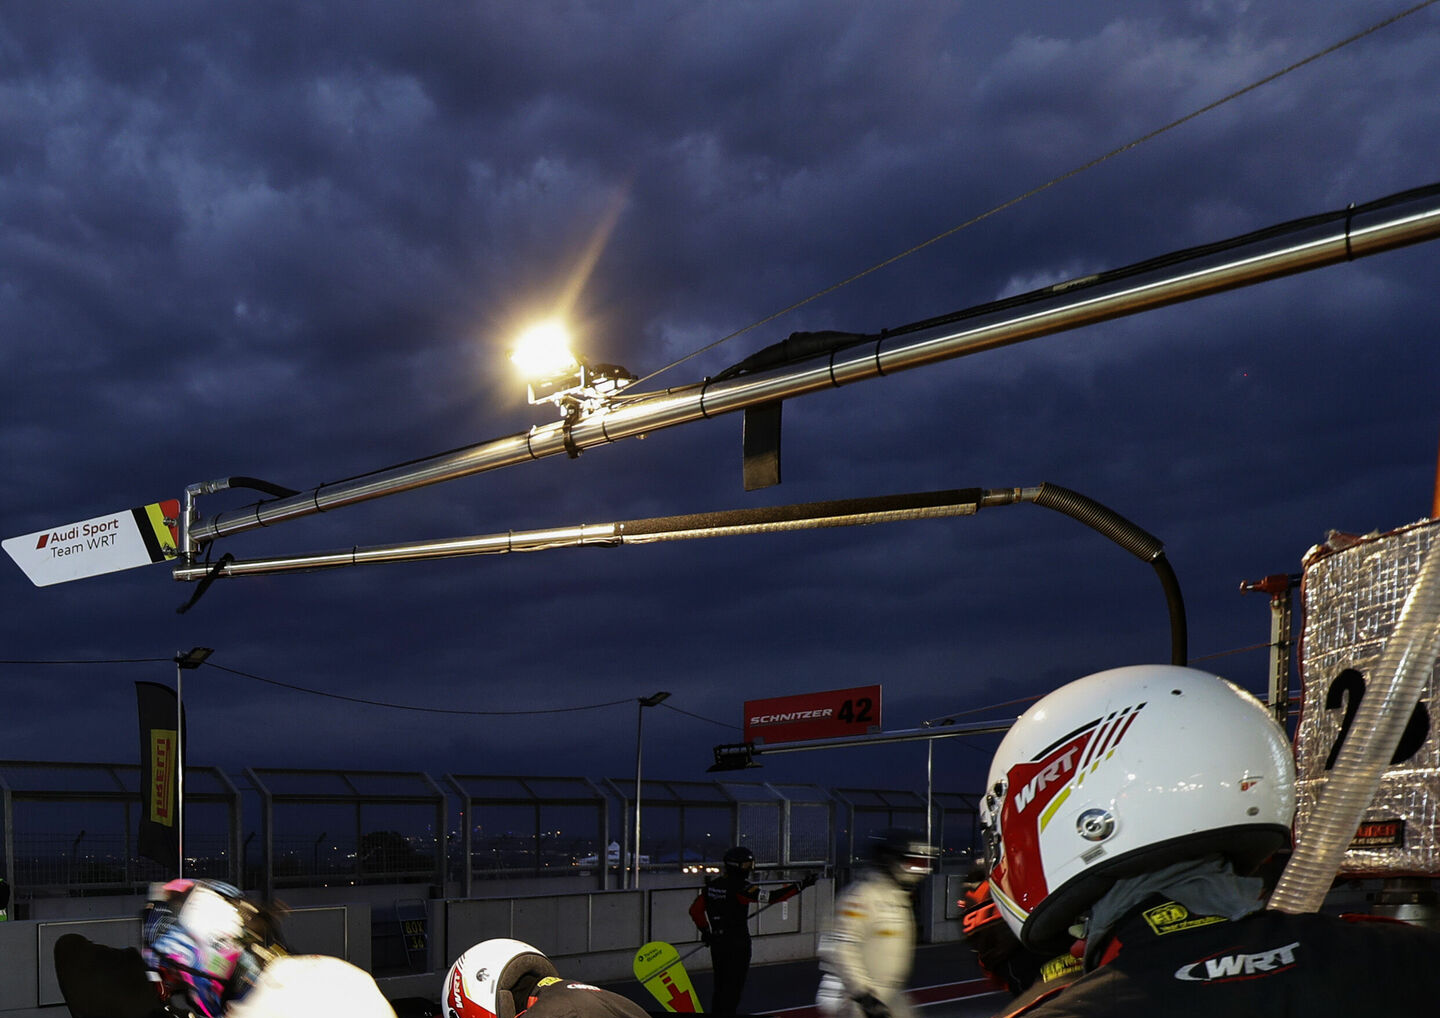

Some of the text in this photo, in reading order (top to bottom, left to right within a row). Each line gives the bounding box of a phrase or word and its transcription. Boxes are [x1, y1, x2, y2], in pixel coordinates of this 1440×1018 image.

[50, 518, 119, 544] Audi Sport
[51, 533, 117, 558] Team WRT
[749, 698, 873, 725] SCHNITZER 42
[1014, 744, 1079, 813] WRT
[1205, 942, 1301, 979] WRT
